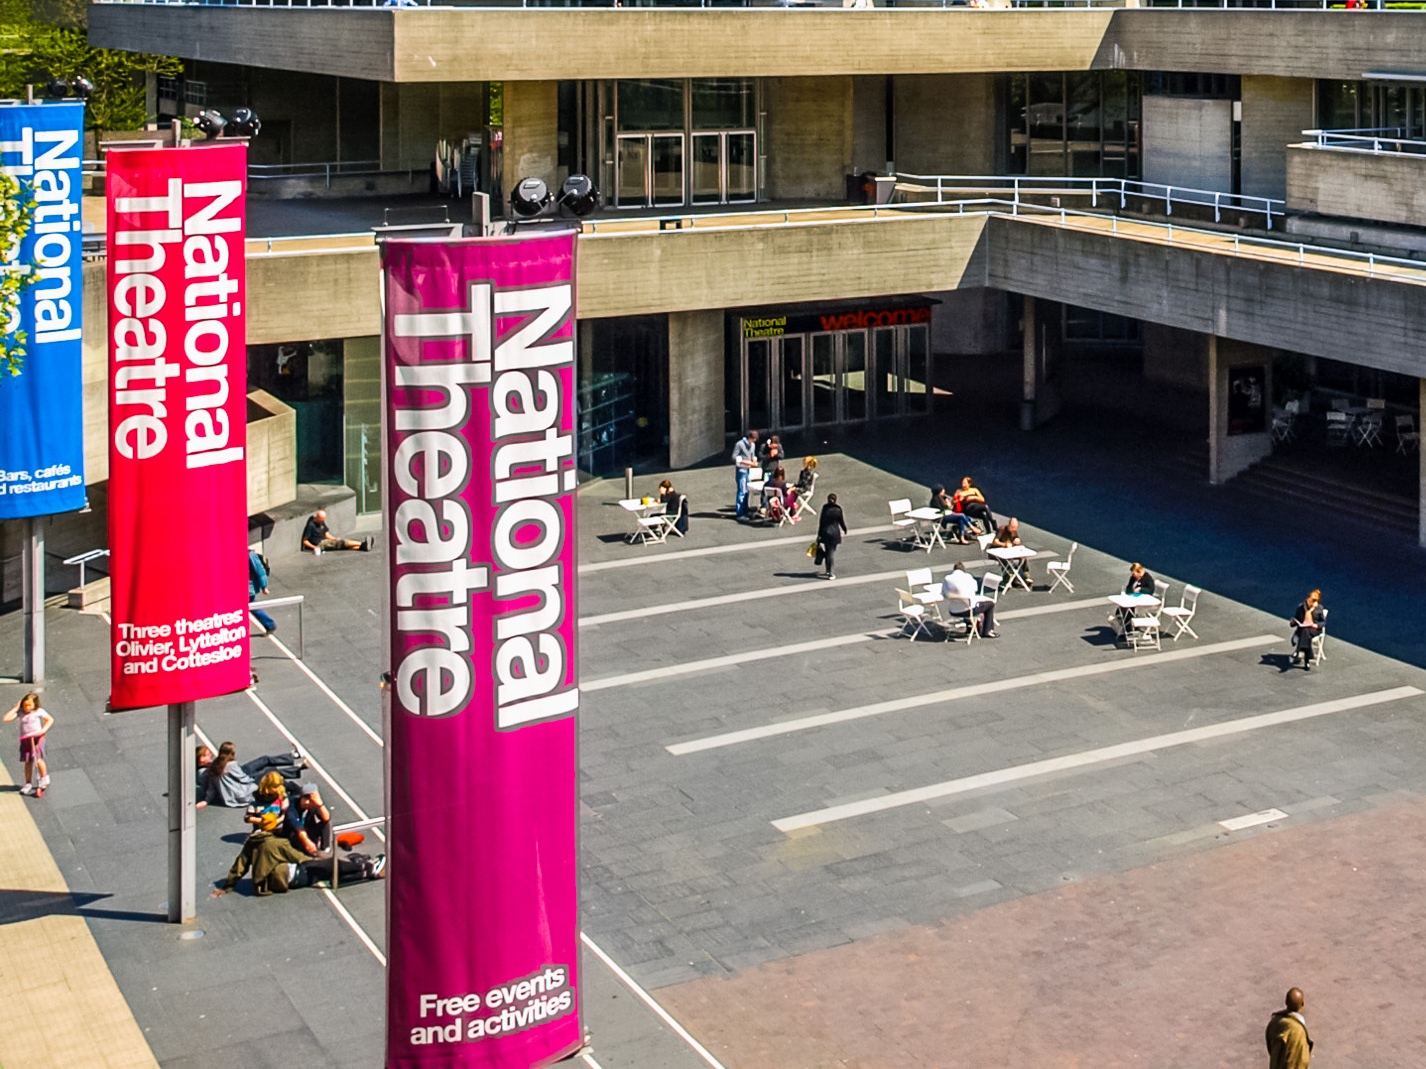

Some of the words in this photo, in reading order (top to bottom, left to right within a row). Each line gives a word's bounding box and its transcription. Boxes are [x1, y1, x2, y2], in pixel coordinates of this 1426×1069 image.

[34, 129, 82, 343] National
[114, 178, 182, 460] Theatre
[183, 180, 243, 469] National
[743, 316, 787, 328] National
[744, 327, 785, 338] Theatre
[820, 306, 931, 331] welcome
[9, 475, 82, 494] restaurants
[35, 464, 71, 478] cafés
[394, 283, 491, 716] Theatre
[494, 284, 579, 728] National
[116, 640, 175, 657] Olivier,
[179, 625, 246, 654] Lyttelton
[118, 623, 171, 639] Three
[124, 657, 158, 674] and
[162, 645, 242, 672] Cottesloe
[420, 993, 480, 1018] Free
[485, 968, 565, 1008] events
[410, 1019, 462, 1045] and
[467, 990, 571, 1039] activities
